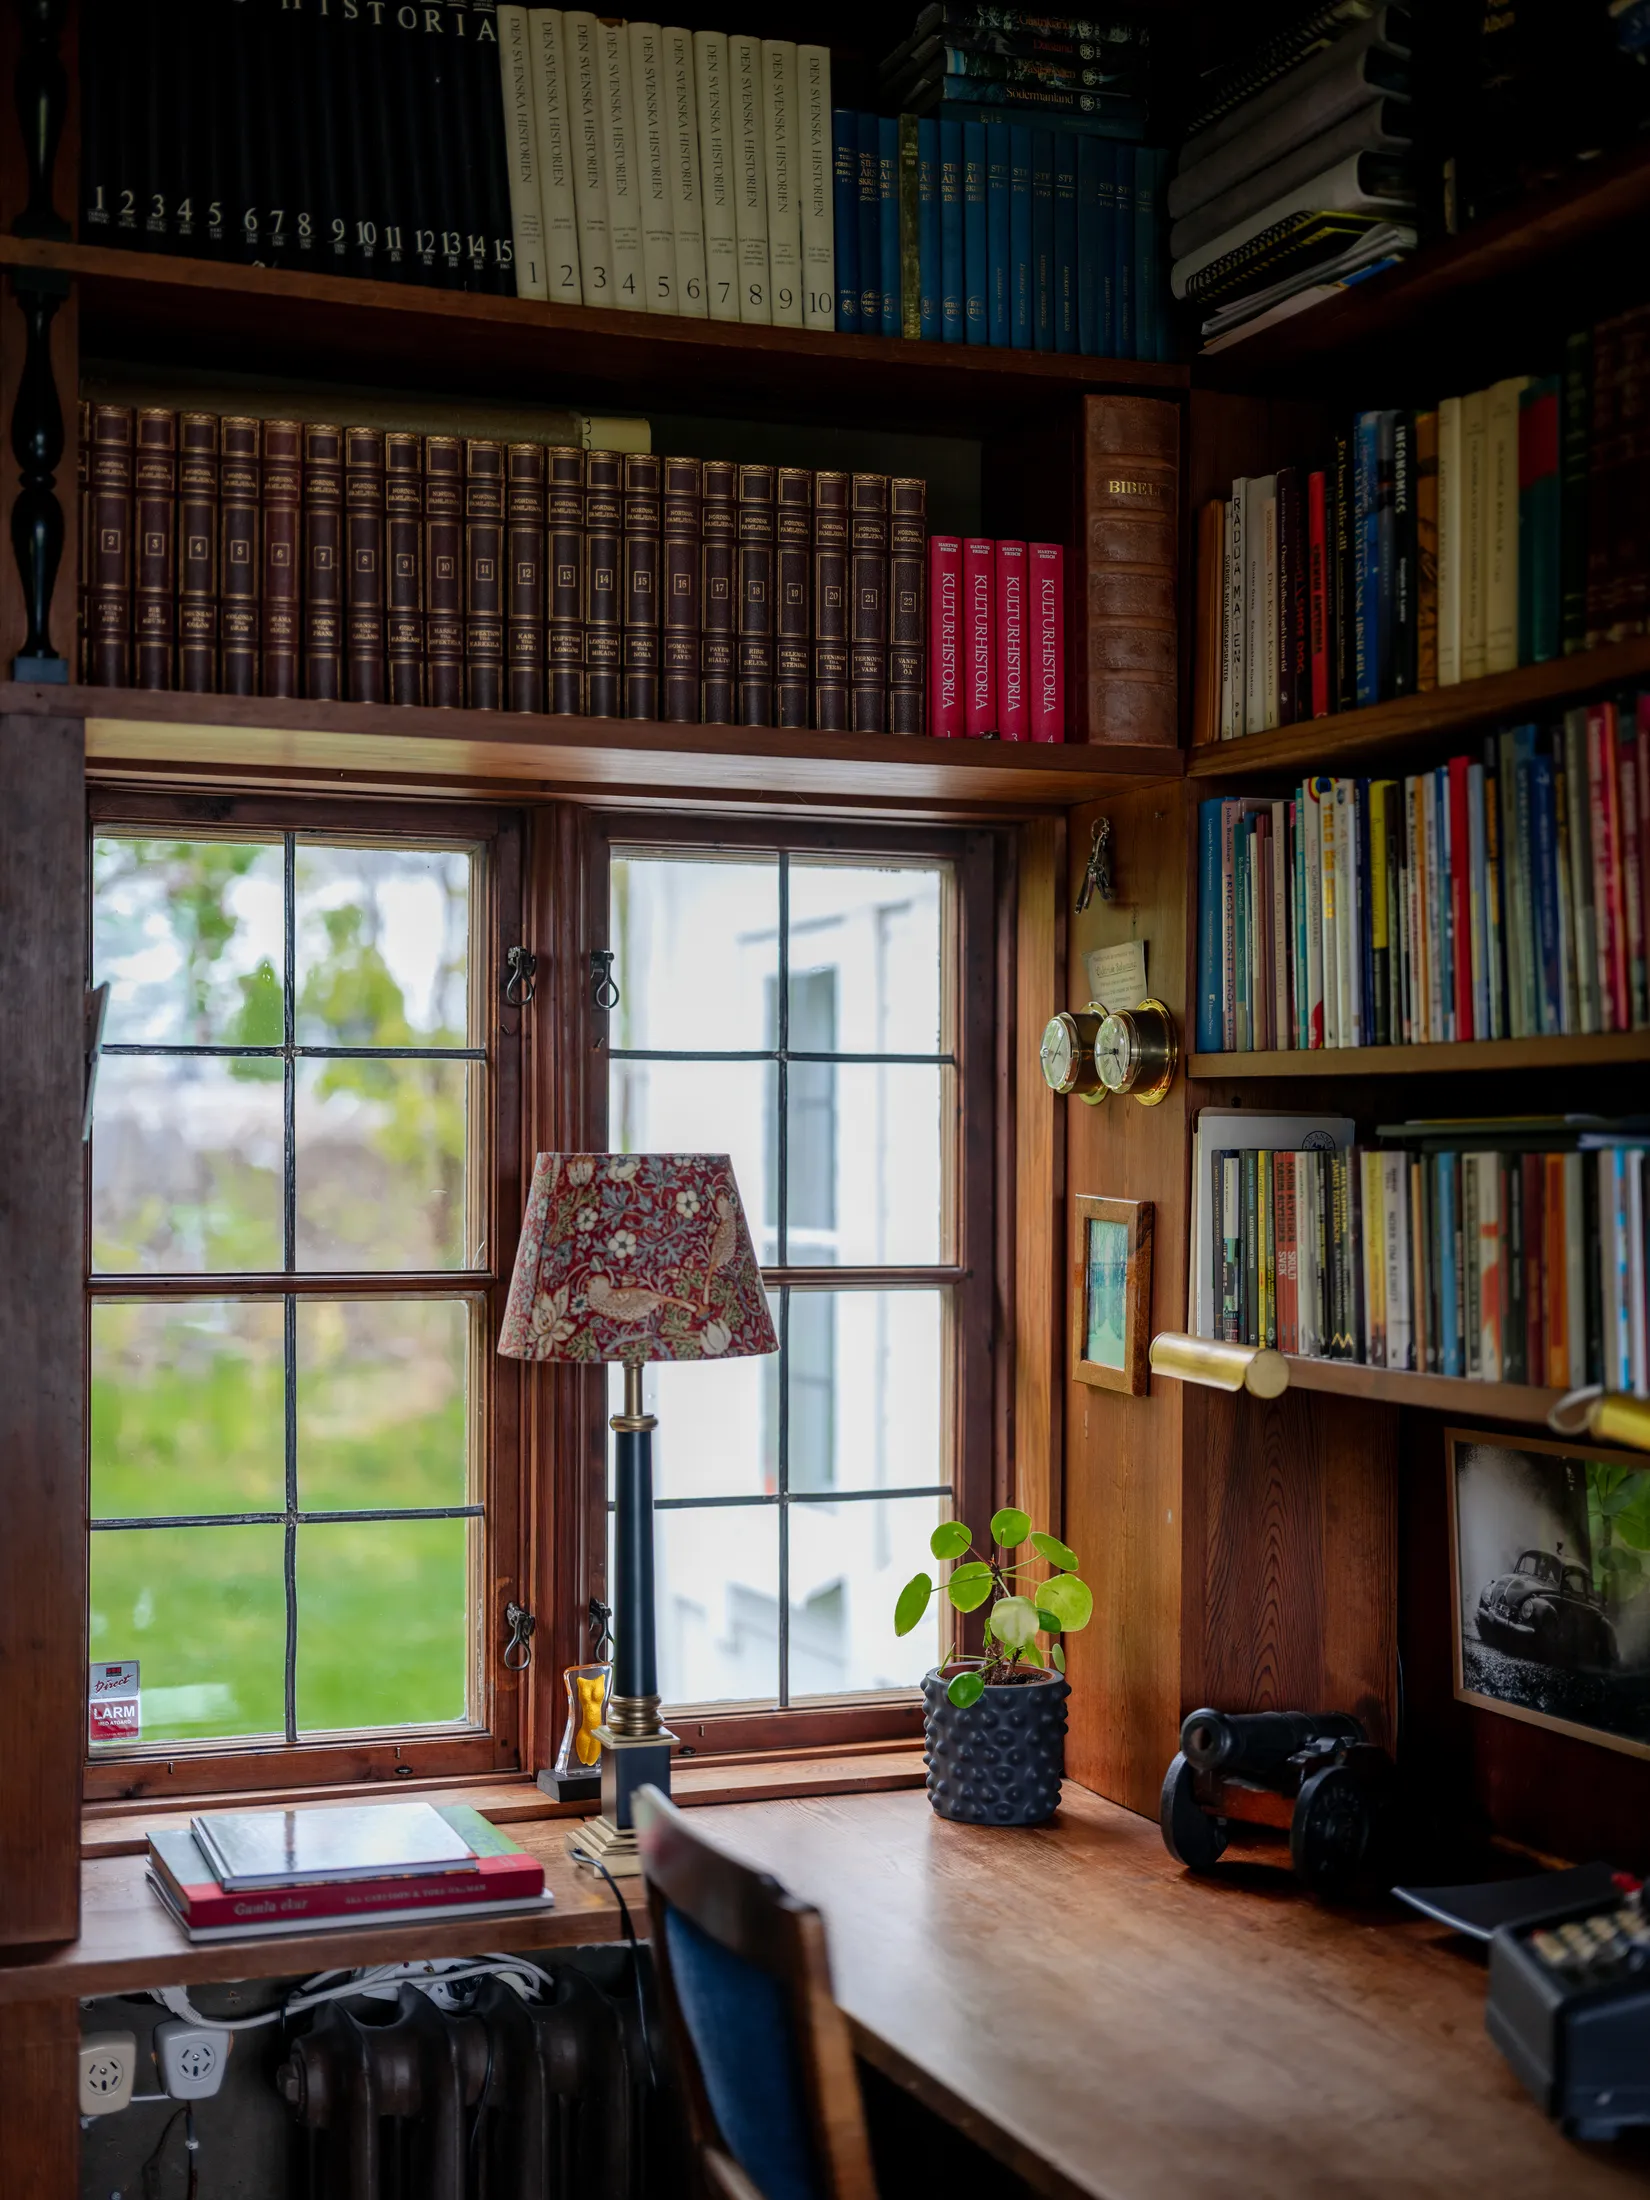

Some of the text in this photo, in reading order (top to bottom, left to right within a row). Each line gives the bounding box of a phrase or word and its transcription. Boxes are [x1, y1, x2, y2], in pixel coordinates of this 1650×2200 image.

[511, 17, 532, 183] DEN SVENSKA HISTORIEN
[543, 22, 564, 186] DEN SVENSKA HISTORIEN
[578, 24, 598, 188] DEN SVENSKA HISTORIEN
[607, 32, 627, 196] DEN SVENSKA HISTORIEN
[643, 36, 662, 199] DEN SVENSKA HISTORIEN
[674, 38, 693, 201] DEN SVENSKA HISTORIEN
[707, 44, 724, 206] DEN SVENSKA HISTORIEN
[740, 46, 757, 208] DEN SVENSKA HISTORIEN
[772, 53, 788, 213] DEN SVENSKA HISTORIEN
[810, 58, 824, 218] DEN SVENSKA HISTORIEN
[96, 186, 105, 209] 1
[119, 189, 137, 214] 2
[151, 193, 166, 217] 3
[177, 197, 194, 221] 4
[208, 201, 223, 226] 5
[244, 207, 258, 230] 6
[269, 209, 285, 233] 7
[297, 212, 311, 236] 8
[331, 218, 345, 242] 9
[355, 220, 377, 245] 10
[384, 225, 403, 250] 11
[415, 229, 436, 254] 12
[441, 231, 461, 256] 13
[467, 234, 487, 258] 14
[494, 238, 513, 262] 15
[529, 262, 536, 283] 1
[561, 265, 574, 286] 2
[594, 267, 606, 287] 3
[623, 274, 635, 294] 4
[658, 277, 670, 297] 5
[687, 278, 700, 298] 6
[718, 282, 730, 302] 7
[750, 284, 762, 304] 8
[780, 288, 792, 309] 9
[810, 292, 832, 313] 10
[1393, 426, 1406, 514] INFONOMICS
[1223, 554, 1231, 591] SVERIGES
[942, 572, 955, 709] KULTURHISTORIA
[974, 574, 988, 711] KULTURHISTORIA
[1006, 576, 1020, 713] KULTURHISTORIA
[1041, 579, 1056, 714] KULTURHISTORIA
[1277, 1251, 1287, 1276] SVEK
[94, 1674, 134, 1693] Direct
[94, 1705, 135, 1720] LARM
